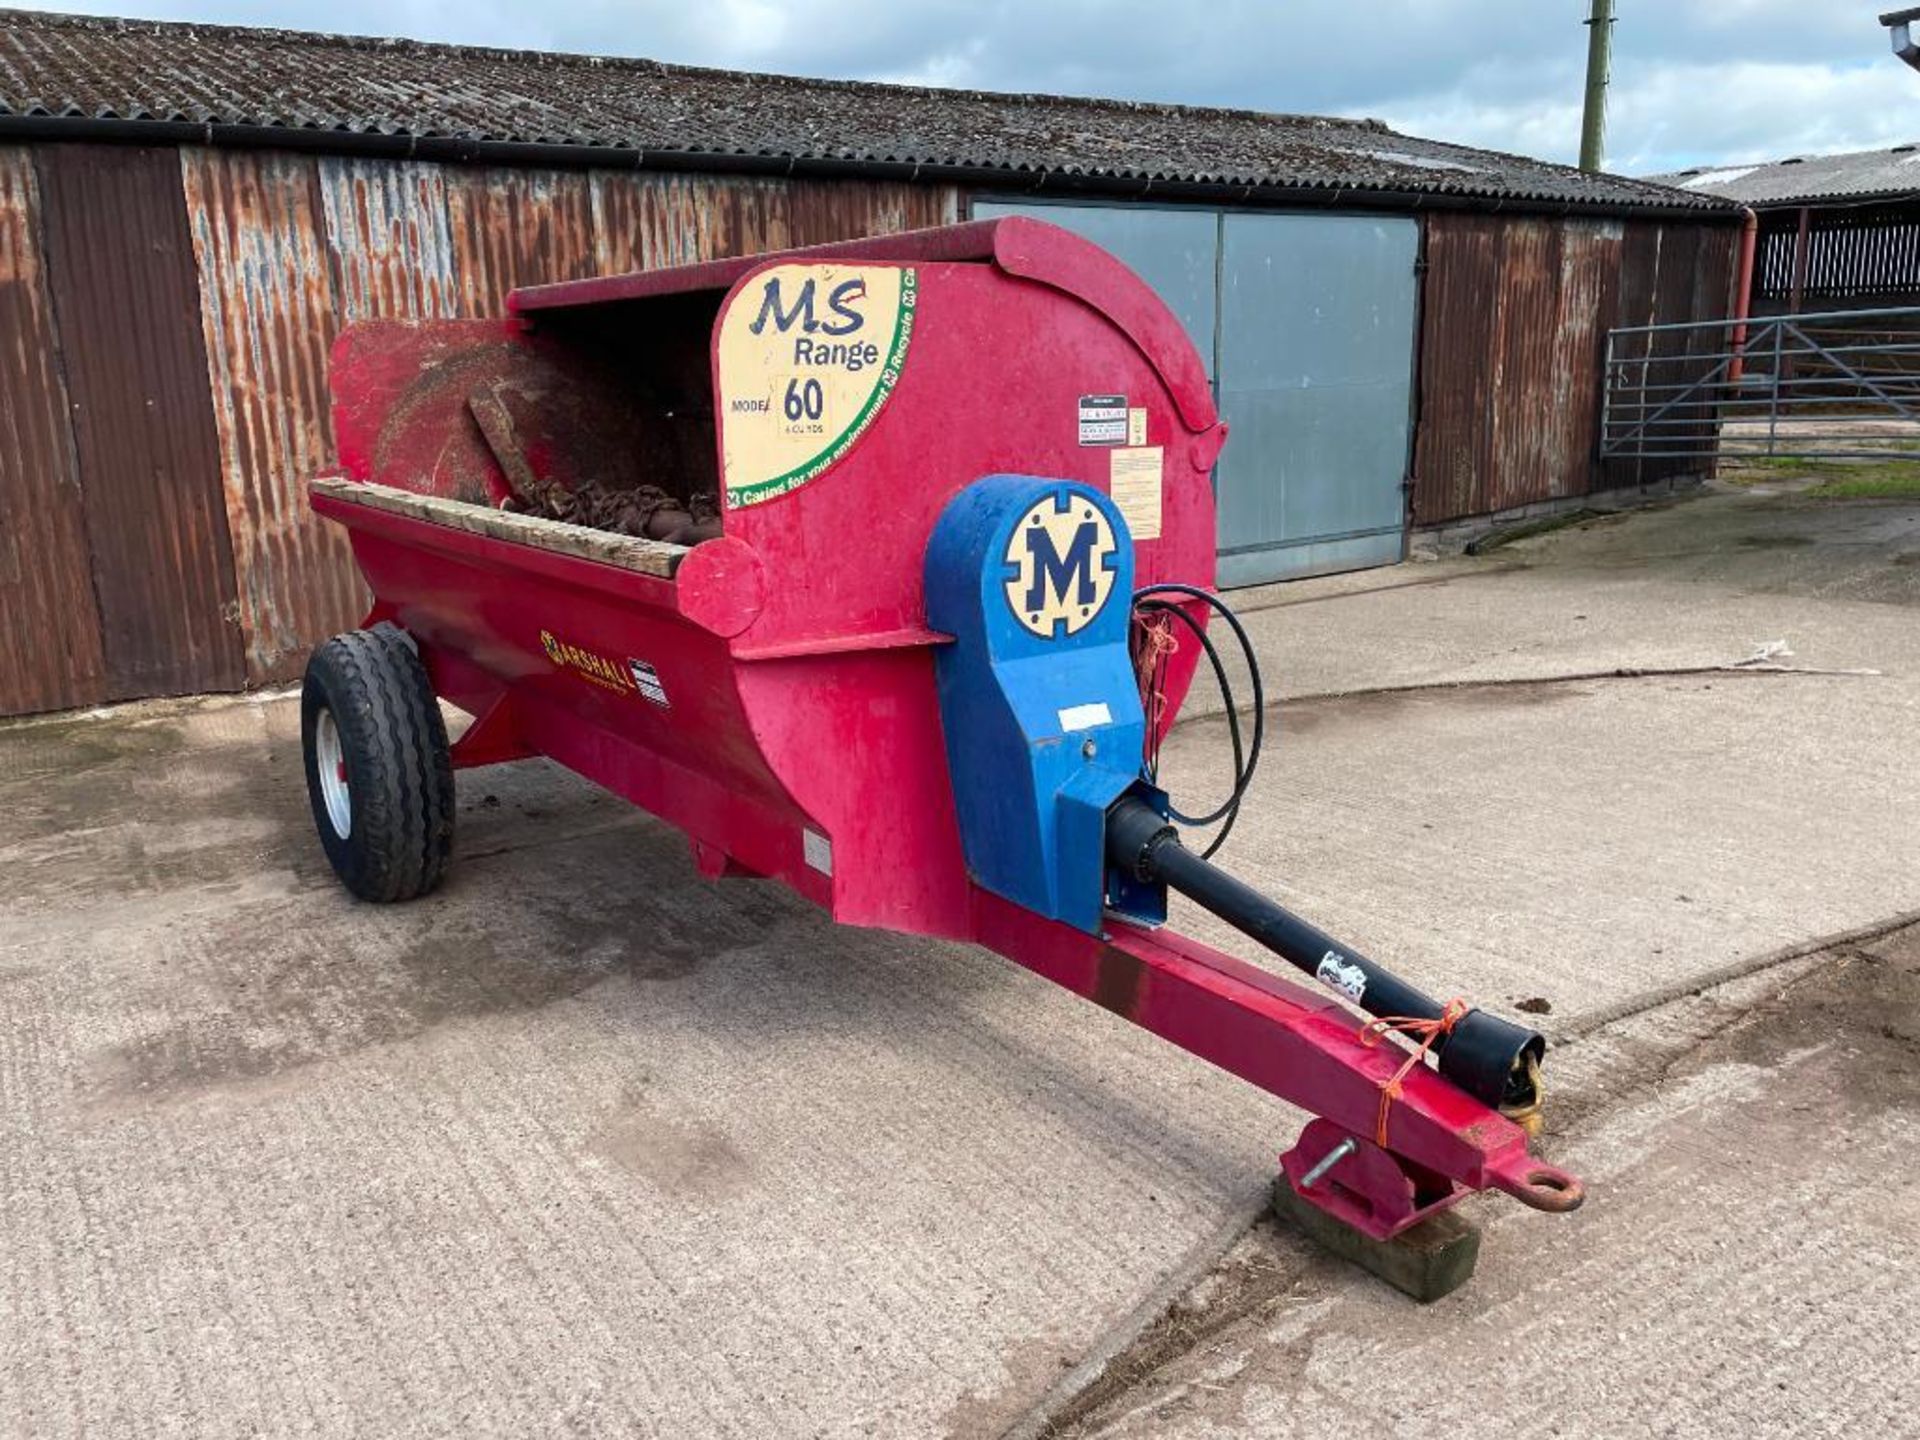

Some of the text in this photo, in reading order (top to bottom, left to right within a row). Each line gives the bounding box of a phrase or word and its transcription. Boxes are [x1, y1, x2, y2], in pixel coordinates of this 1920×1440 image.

[750, 277, 867, 336] MS
[794, 338, 879, 372] Range
[743, 482, 788, 506] Caring
[788, 475, 806, 492] for
[807, 457, 832, 480] your
[833, 387, 889, 460] environment
[891, 312, 913, 370] Recycle
[784, 377, 823, 421] 60
[1026, 522, 1098, 613] M
